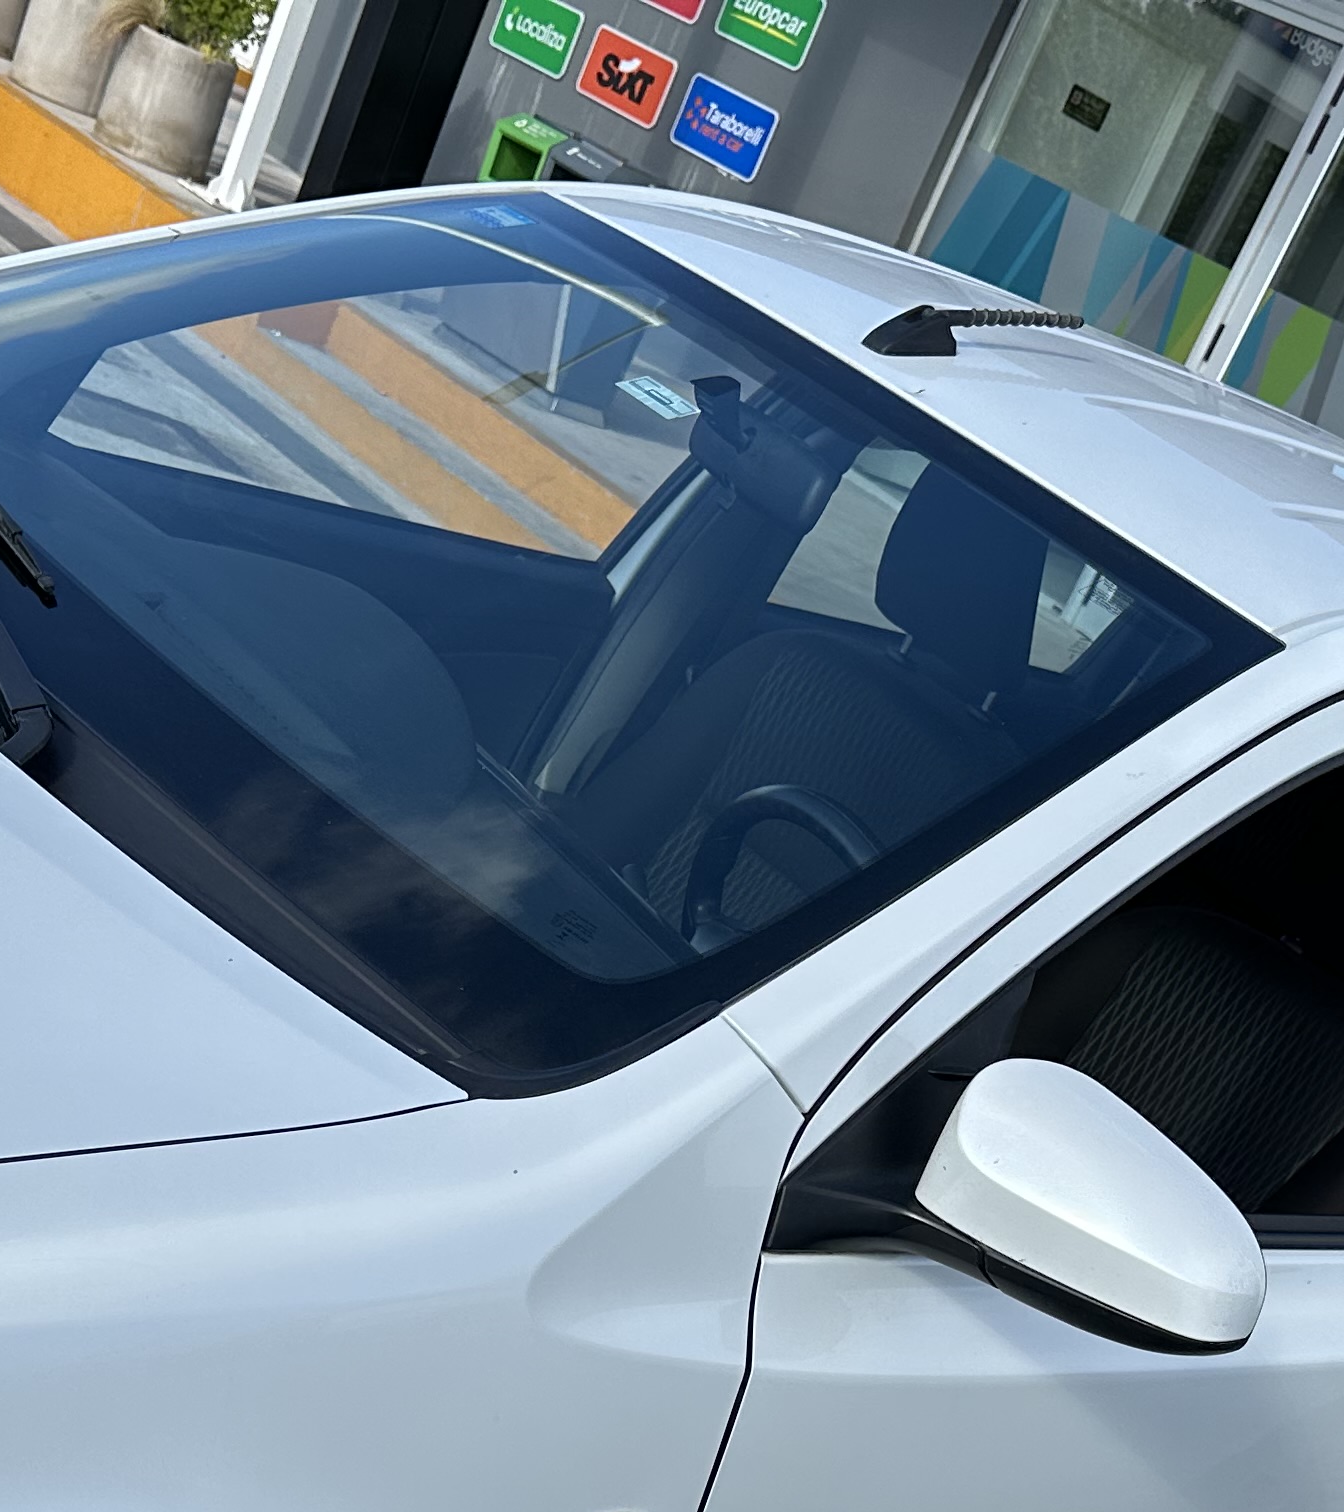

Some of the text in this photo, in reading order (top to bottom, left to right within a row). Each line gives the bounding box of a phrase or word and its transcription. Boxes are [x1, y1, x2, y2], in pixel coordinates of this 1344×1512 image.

[733, 0, 808, 37] Europcar
[1289, 28, 1335, 67] Budge
[705, 102, 765, 147] Taraborelli
